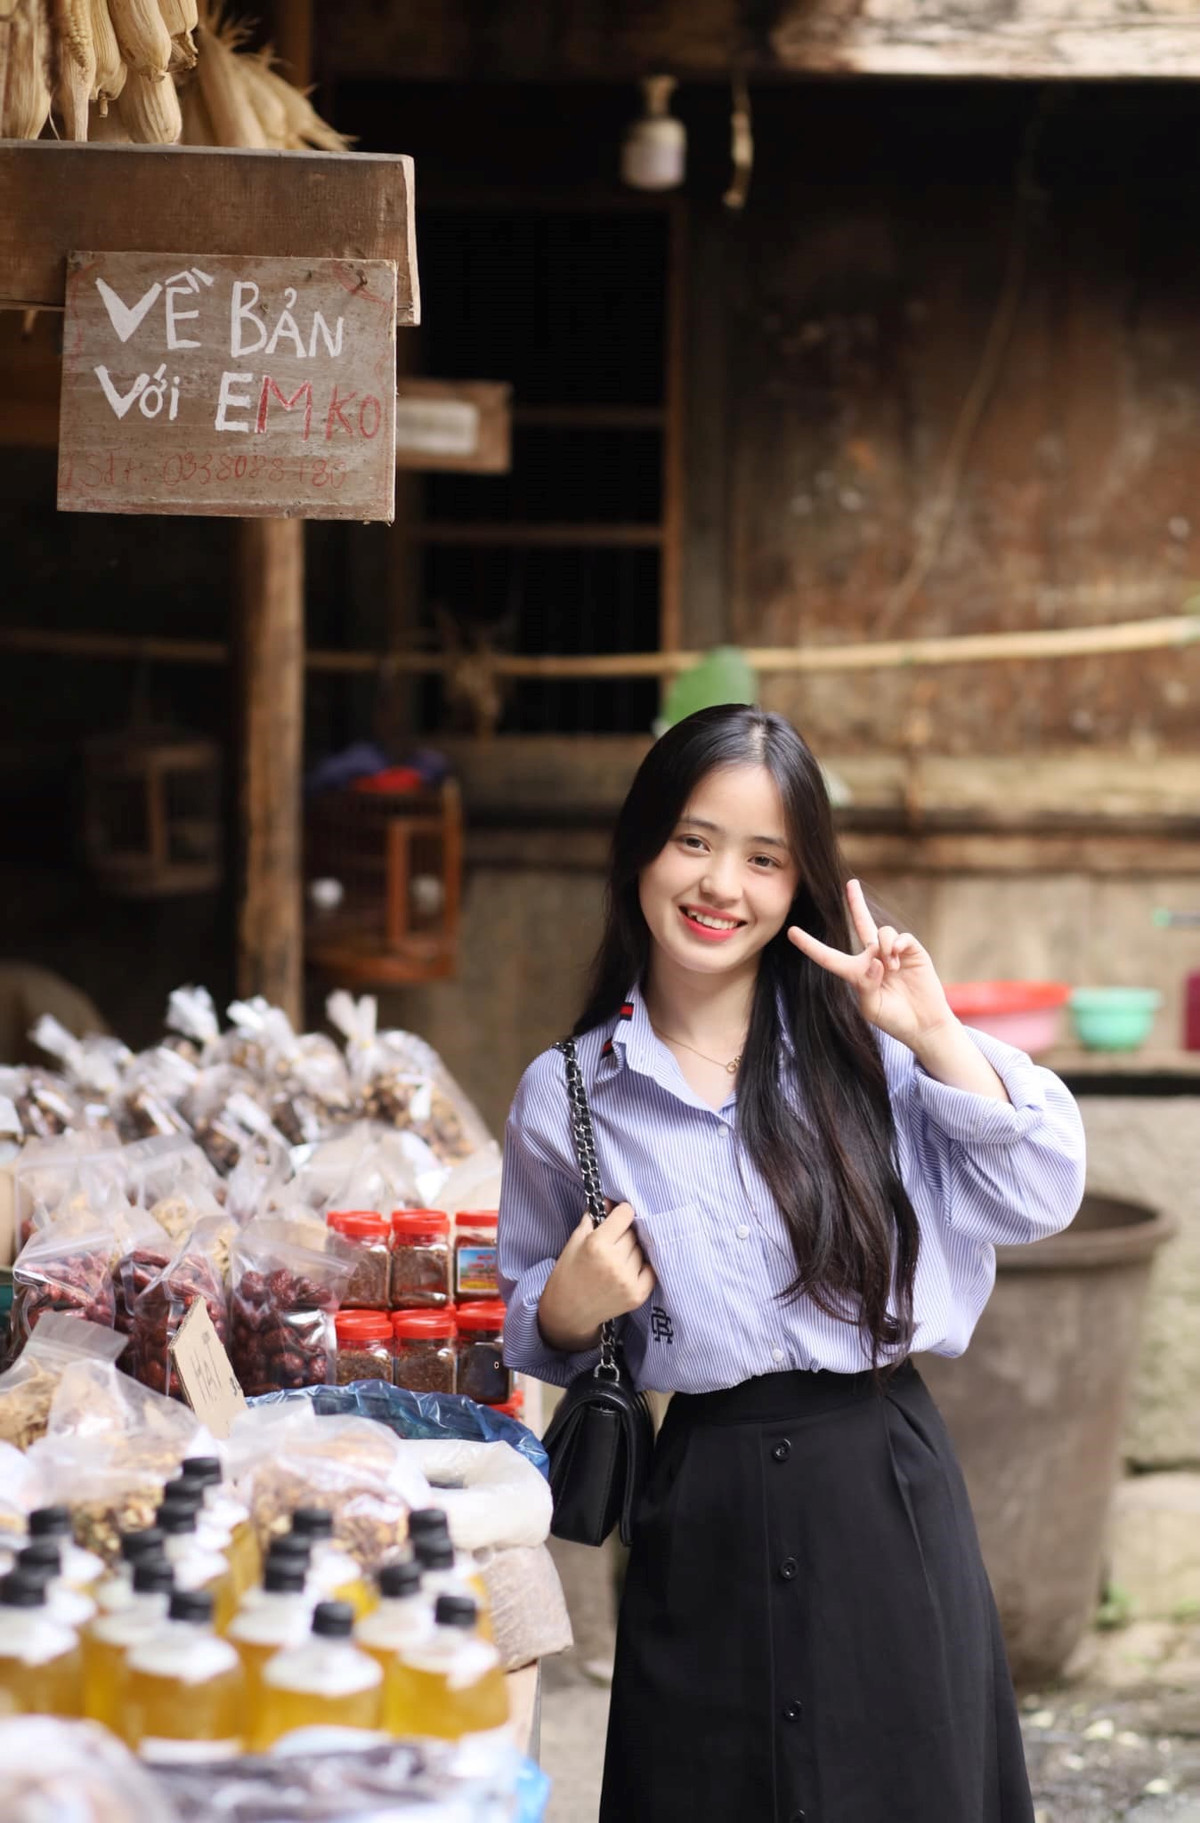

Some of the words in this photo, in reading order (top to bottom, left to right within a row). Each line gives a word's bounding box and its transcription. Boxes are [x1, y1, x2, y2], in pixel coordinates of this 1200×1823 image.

[95, 267, 214, 350] VỀ
[230, 280, 345, 359] BẢN
[93, 363, 181, 421] Với
